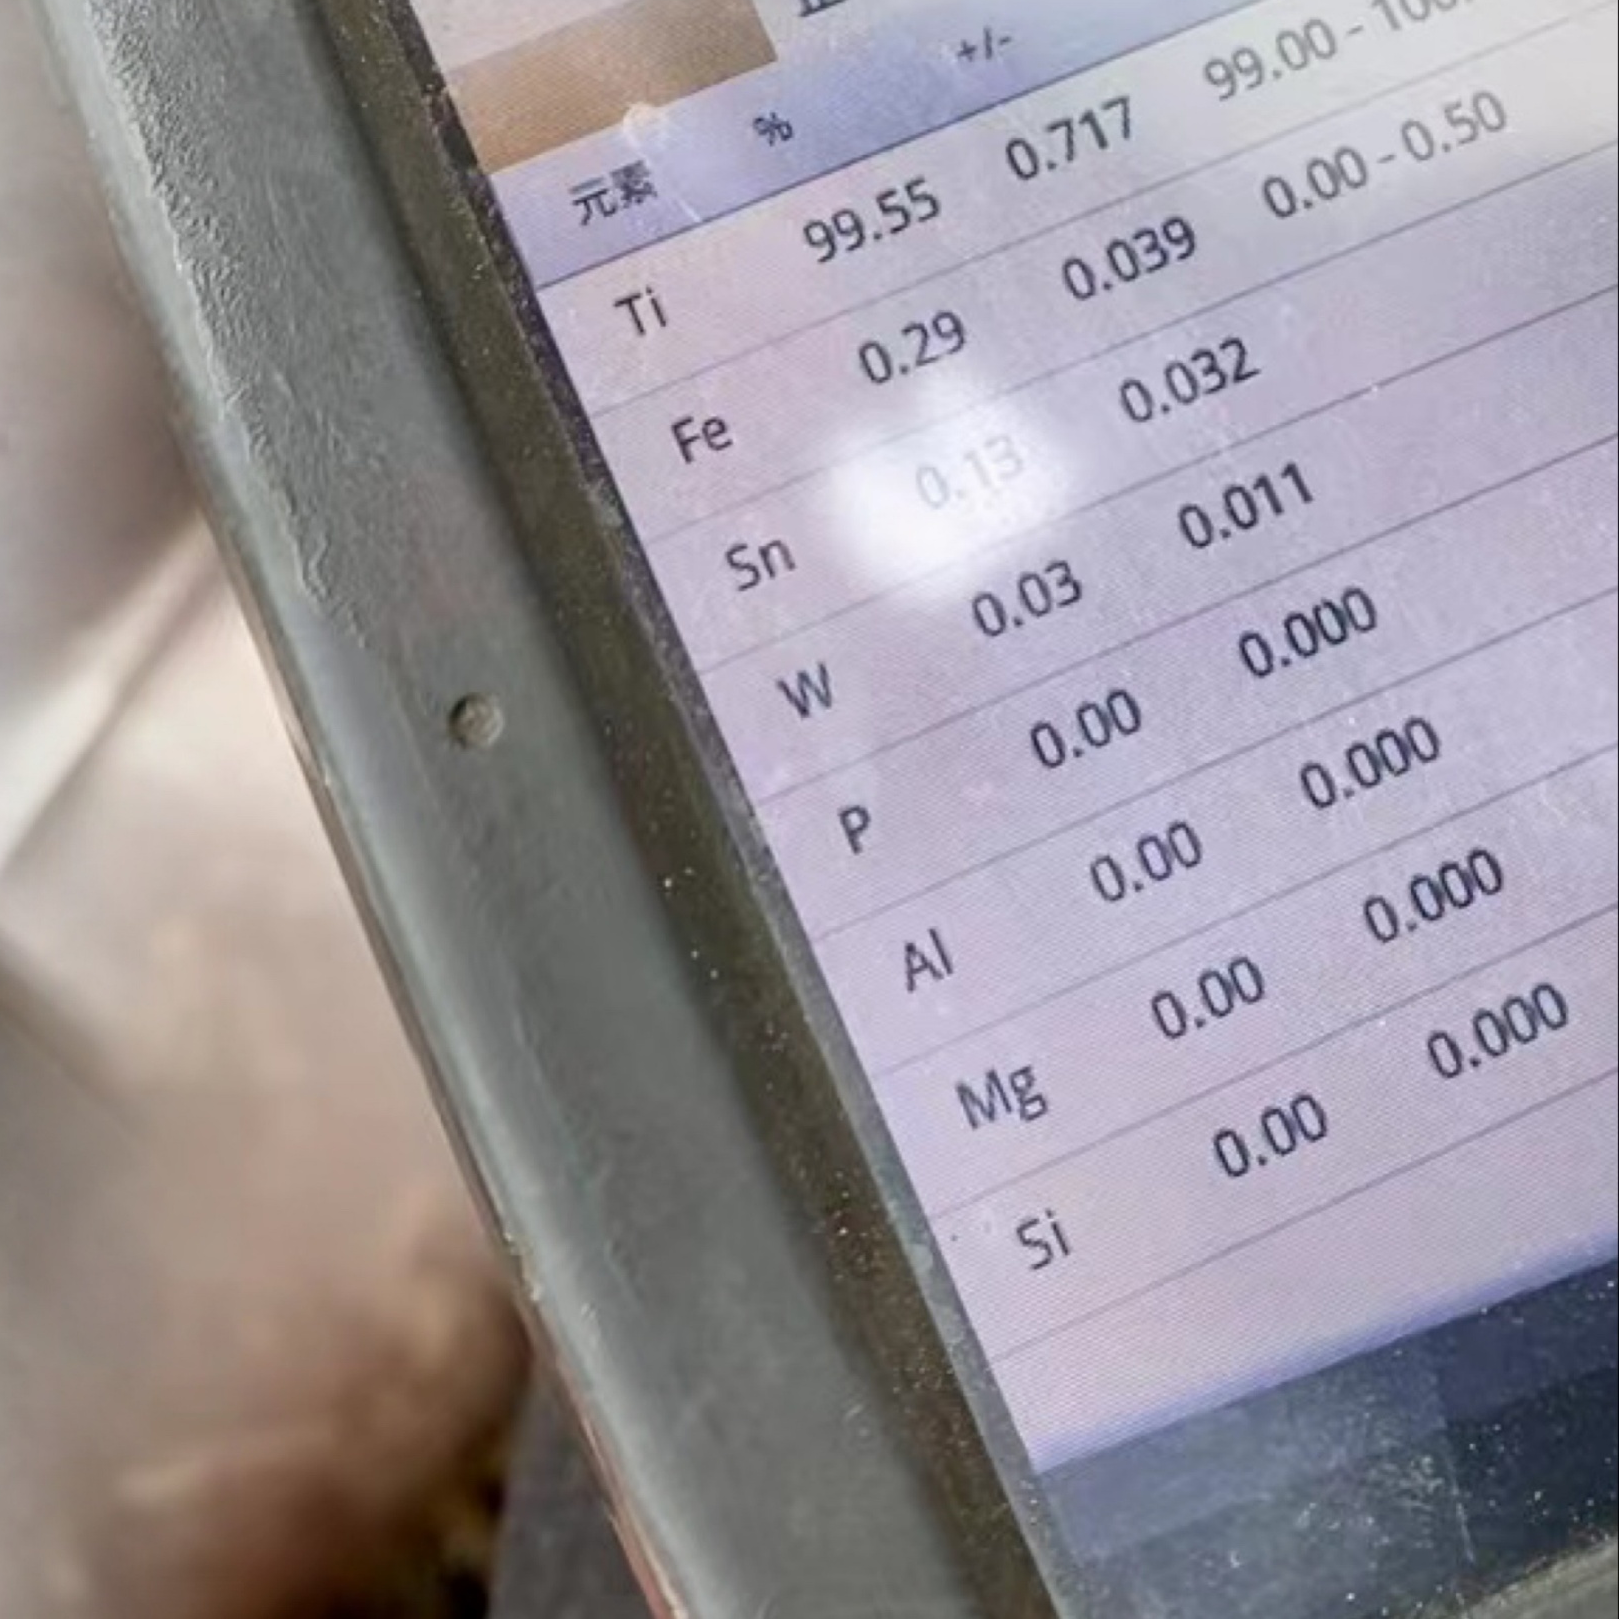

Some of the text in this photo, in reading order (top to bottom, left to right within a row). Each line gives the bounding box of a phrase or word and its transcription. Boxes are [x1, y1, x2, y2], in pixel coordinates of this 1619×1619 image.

[570, 160, 659, 226] 元素
[752, 110, 793, 146] %
[956, 26, 1012, 64] +/-
[615, 286, 667, 336] Ti
[804, 176, 939, 262] 99.55
[1006, 97, 1132, 180] 0.717
[671, 413, 732, 463] Fe
[858, 310, 964, 385] 0.29
[1062, 216, 1196, 301] 0.039
[726, 337, 1260, 592] Sn 0.13 0.032
[777, 462, 1314, 719] W 0.03 0.011
[838, 586, 1378, 854] P 0.00 0.000
[903, 716, 1441, 992] Al 0.00 0.000
[954, 848, 1504, 1129] Mg 0.00 0.000
[1016, 983, 1569, 1271] Si 0.00 0.000
